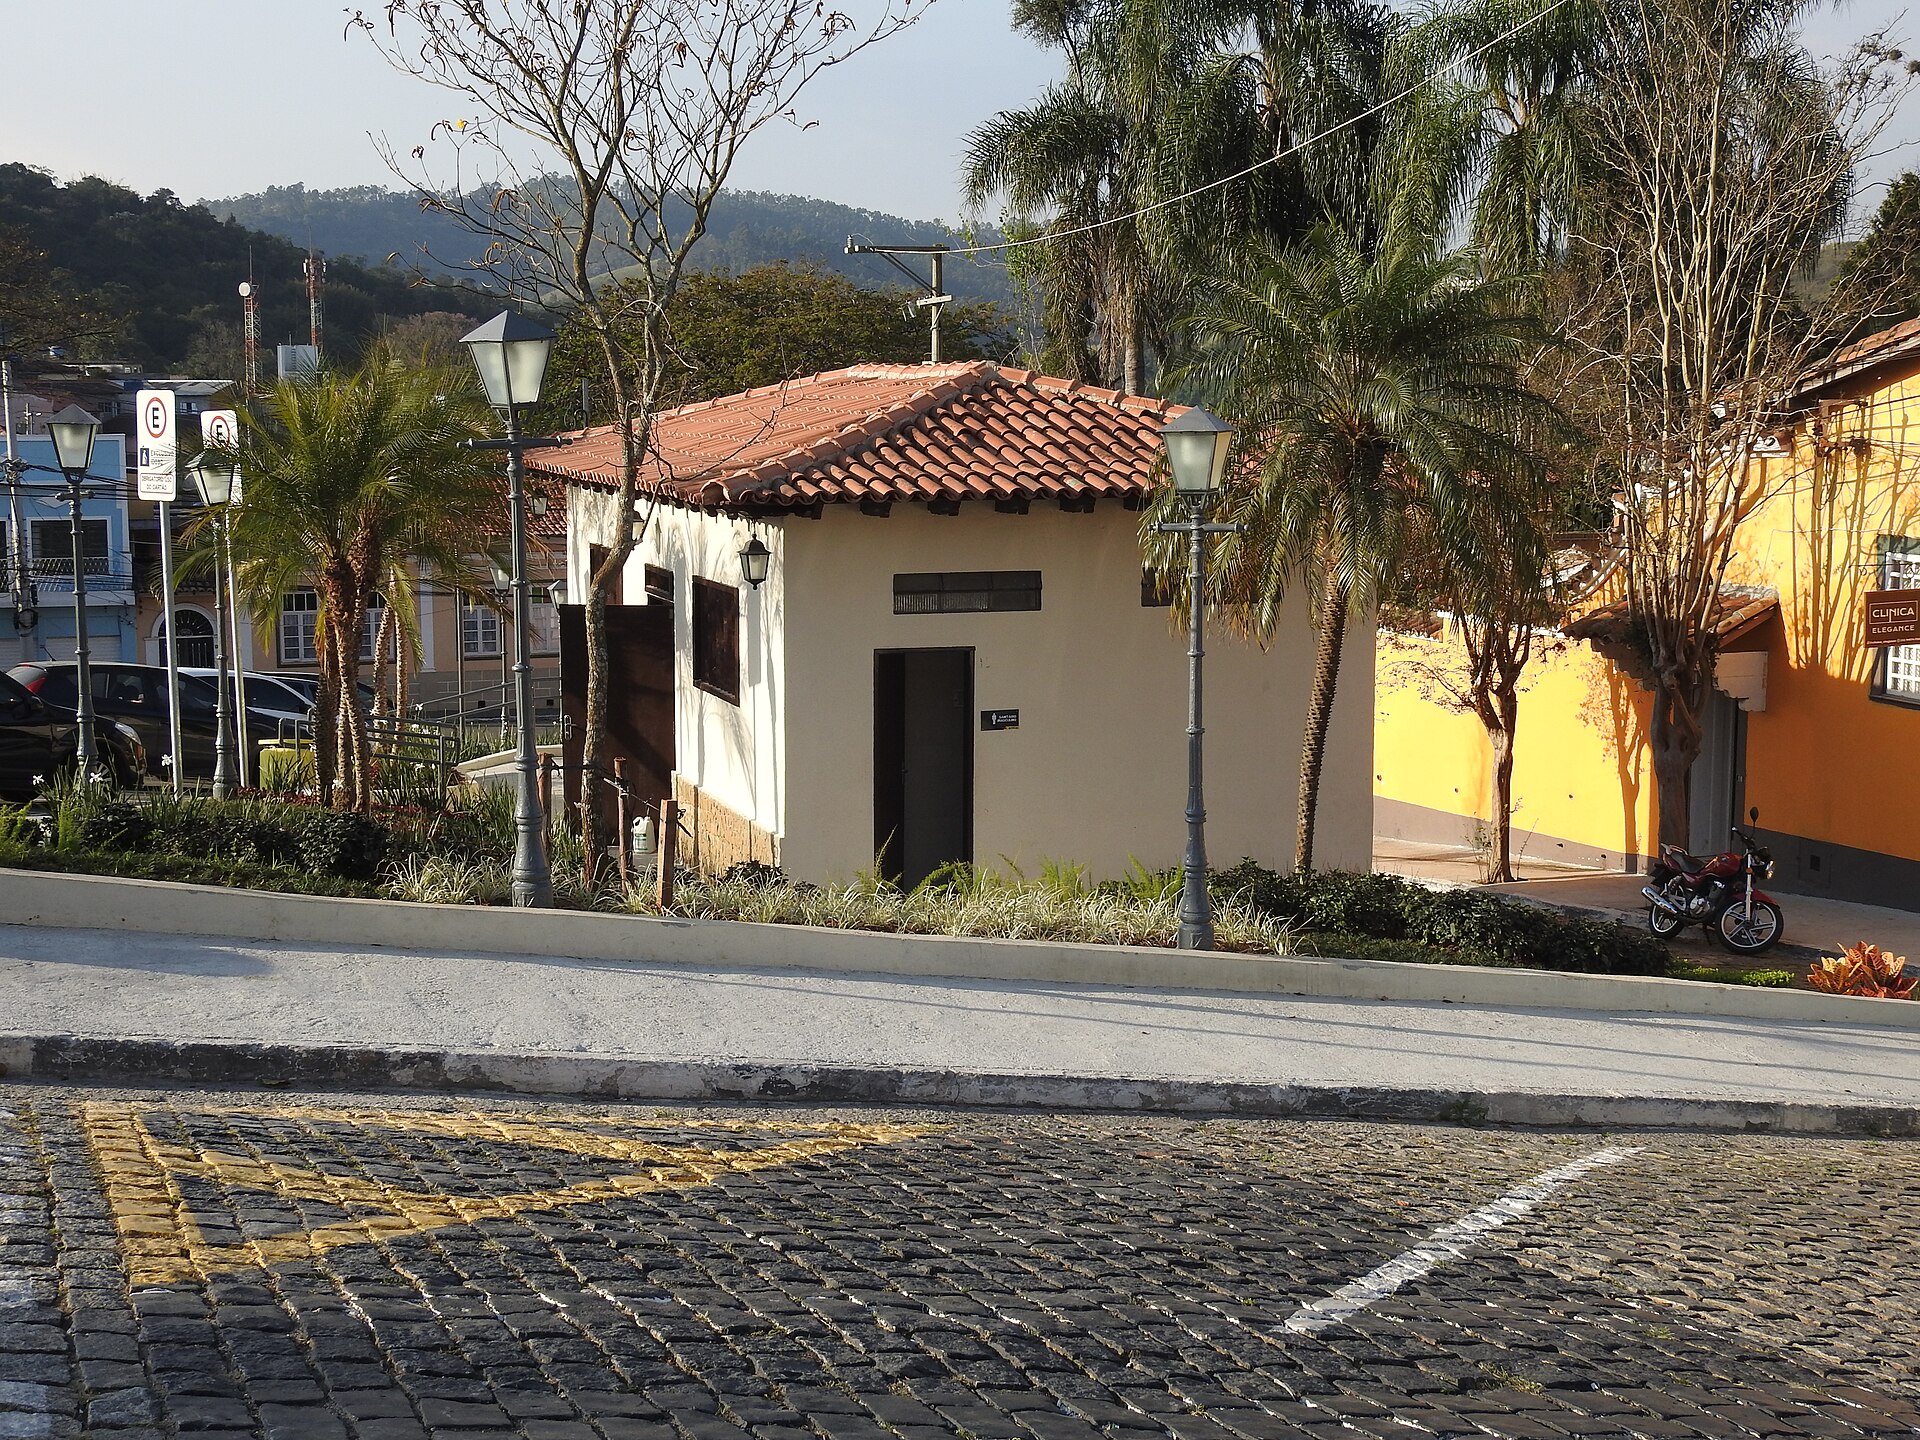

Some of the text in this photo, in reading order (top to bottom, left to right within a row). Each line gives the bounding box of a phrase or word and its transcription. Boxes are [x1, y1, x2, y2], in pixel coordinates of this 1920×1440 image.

[152, 407, 160, 429] E
[216, 424, 226, 444] E
[1872, 607, 1915, 622] CLINICA
[1872, 624, 1915, 634] ELEGANCE
